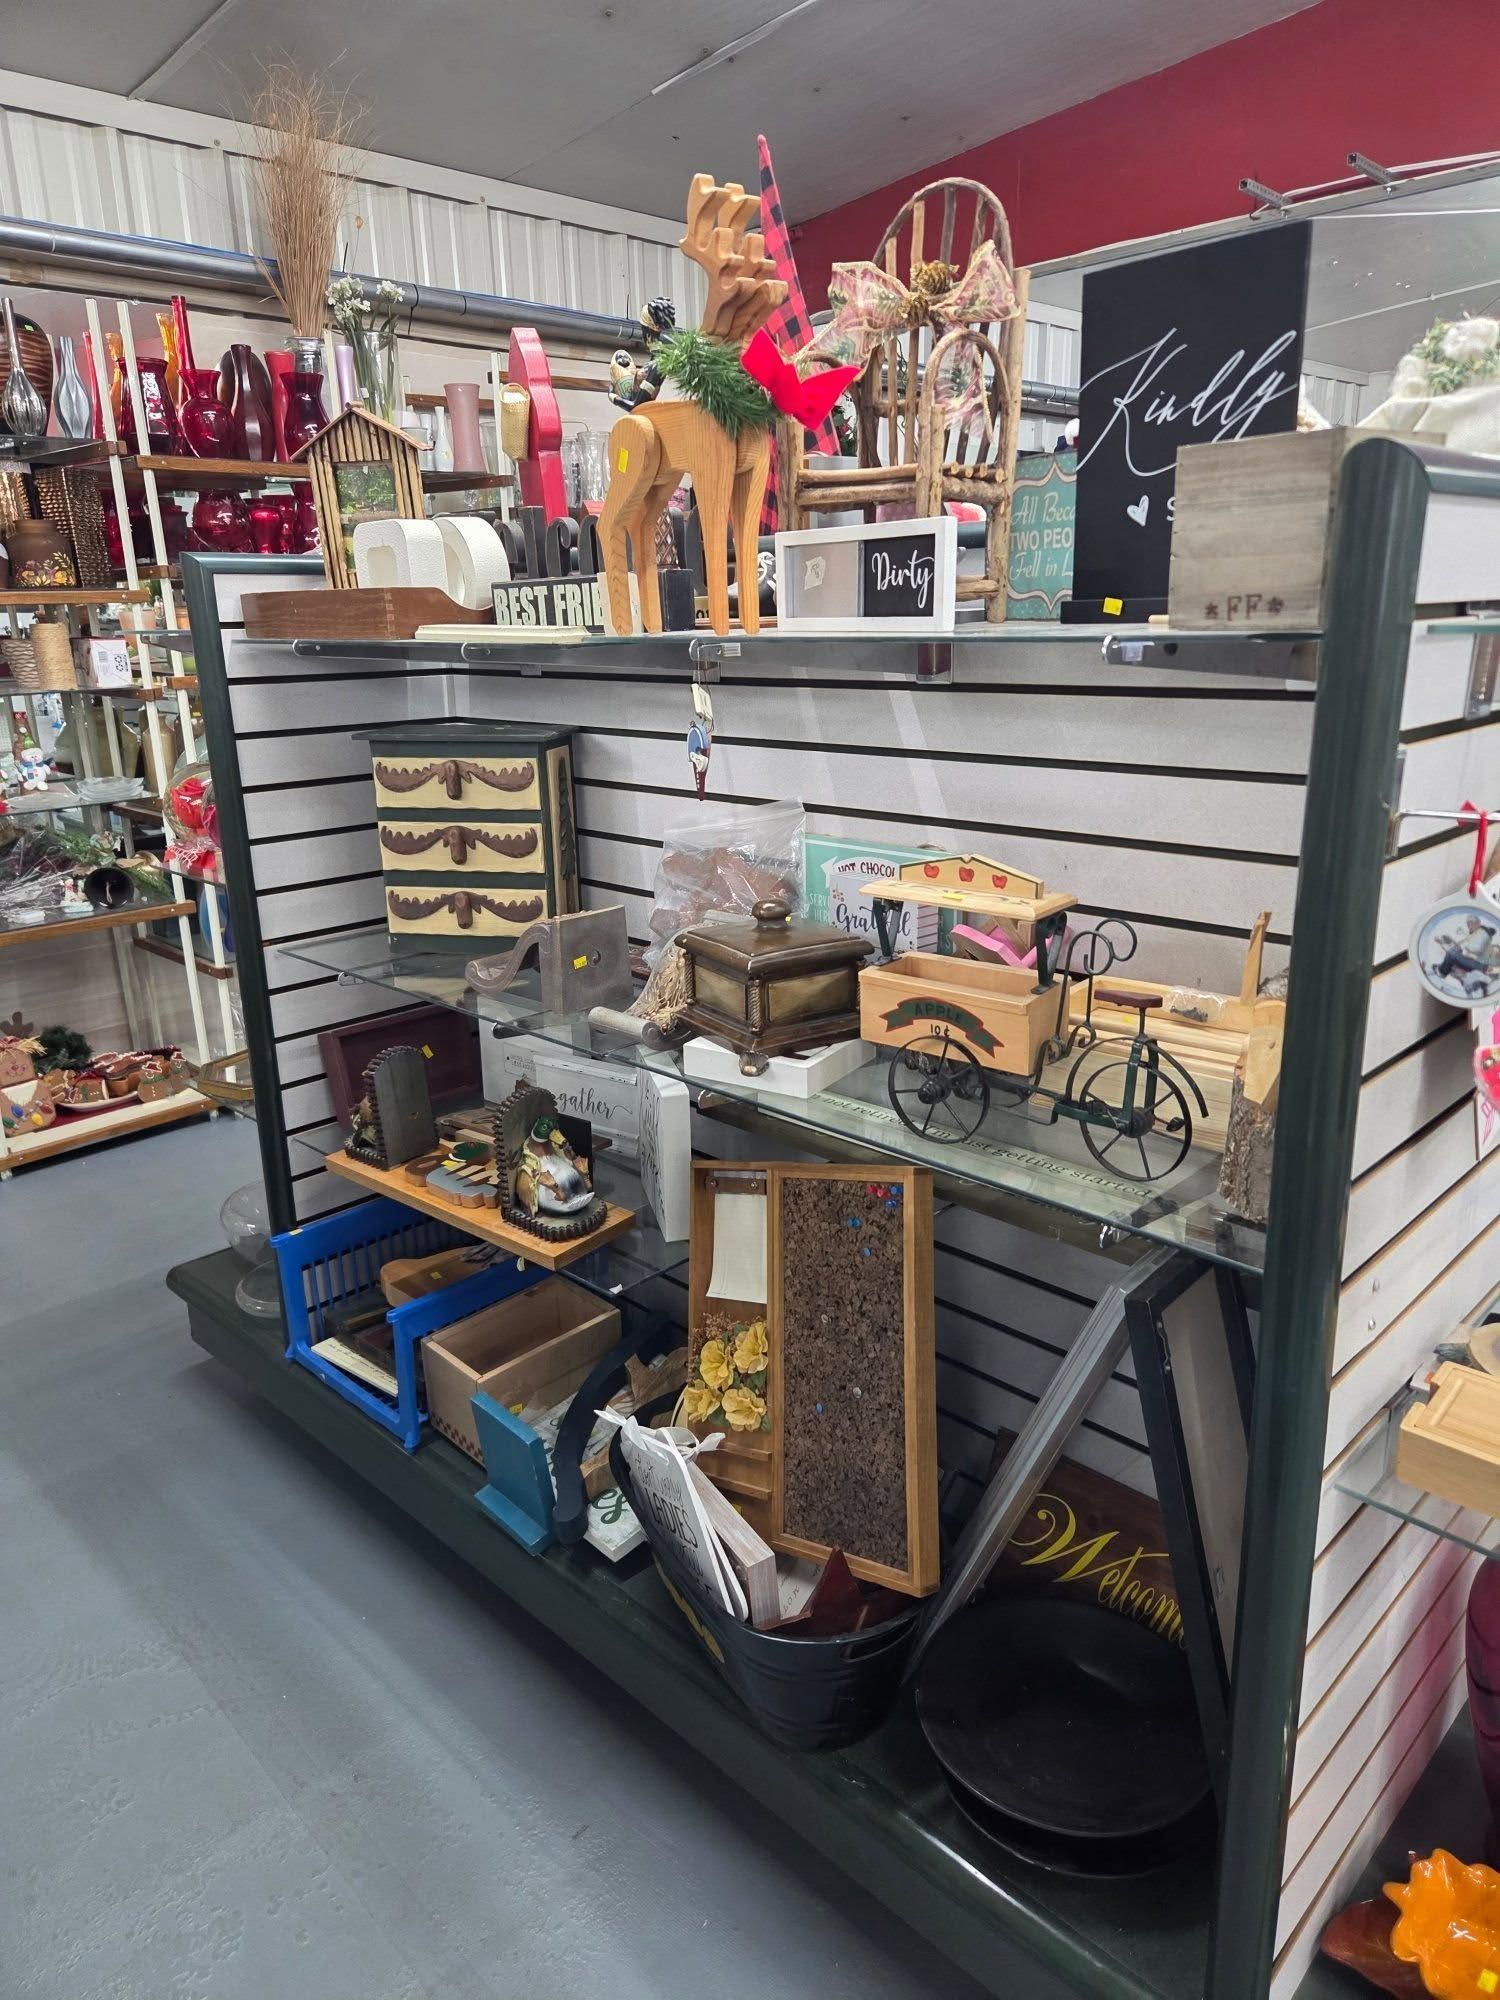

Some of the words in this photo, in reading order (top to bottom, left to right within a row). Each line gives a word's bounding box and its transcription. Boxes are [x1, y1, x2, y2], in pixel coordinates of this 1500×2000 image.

[1078, 327, 1298, 477] Kindly
[1010, 495, 1038, 524] All
[1011, 530, 1039, 551] TWO
[871, 550, 935, 609] Dirty
[1009, 550, 1041, 580] Fell
[1045, 556, 1058, 577] in
[493, 586, 548, 626] BEST
[915, 1002, 963, 1023] APPLE
[556, 1087, 633, 1120] gather
[822, 1098, 850, 1109] not
[991, 1147, 1068, 1174] getting
[646, 1488, 698, 1549] LADIES
